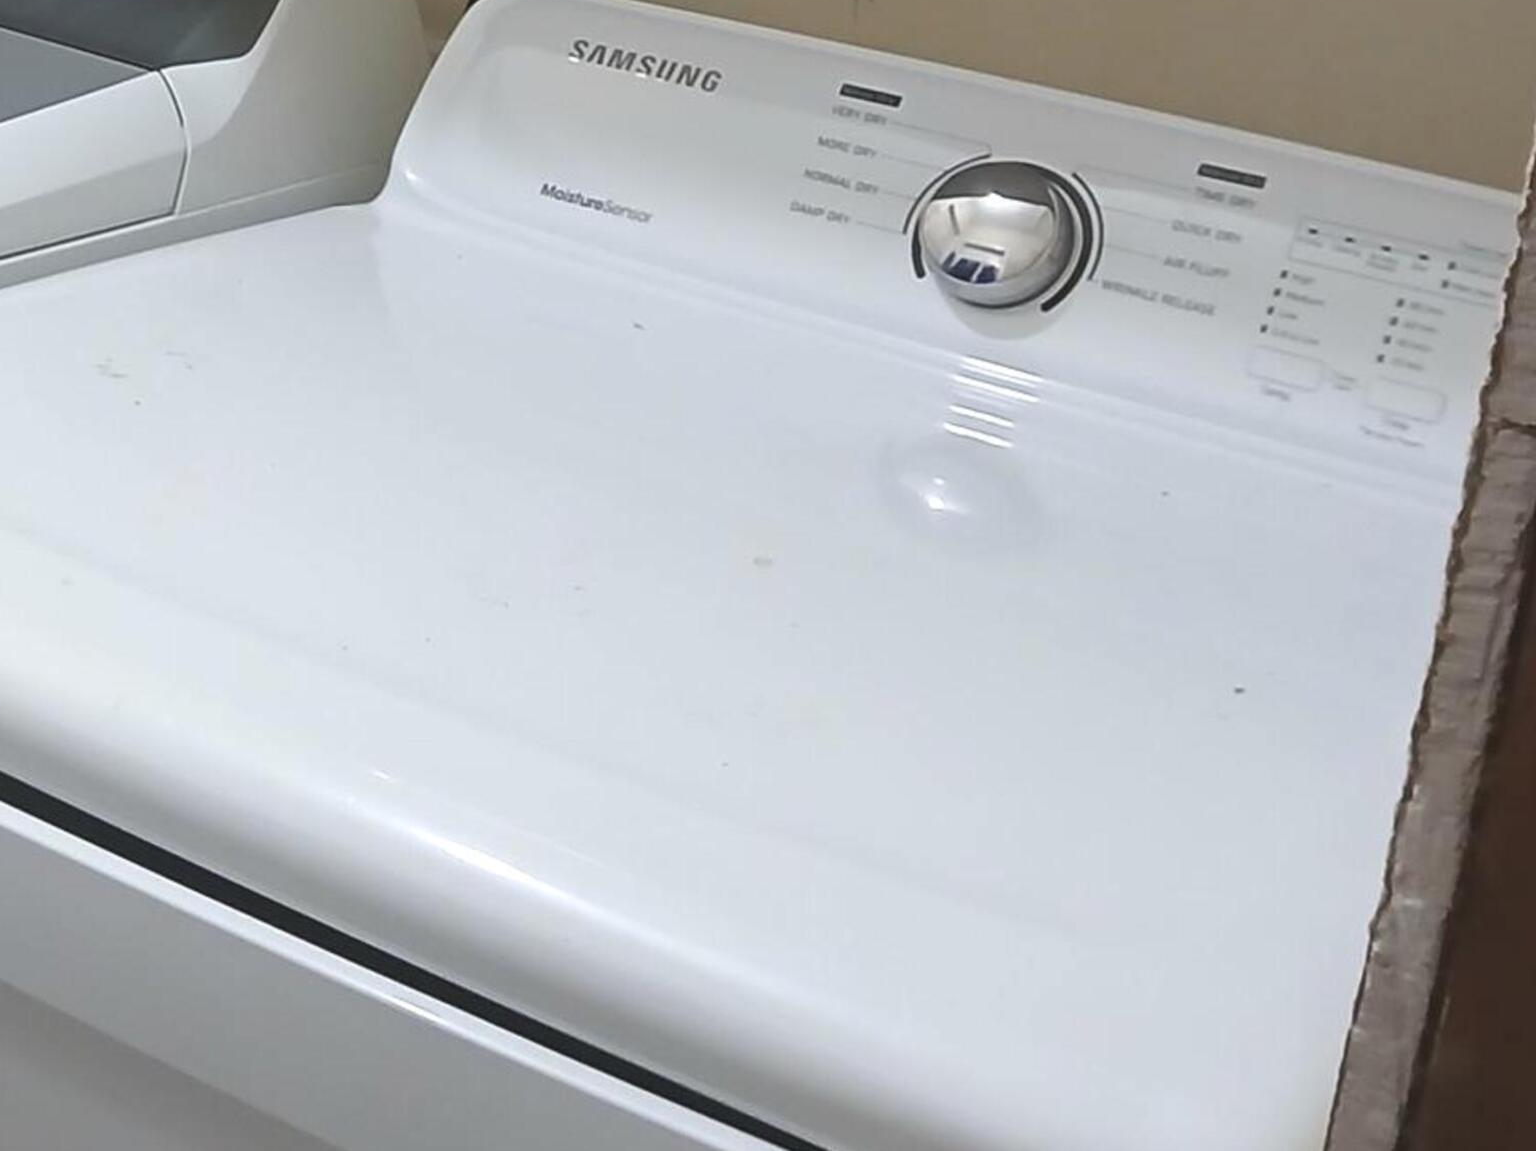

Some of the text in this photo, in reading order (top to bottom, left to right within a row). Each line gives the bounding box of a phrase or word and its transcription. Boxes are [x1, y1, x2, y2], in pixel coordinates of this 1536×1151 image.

[567, 38, 723, 94] SAMSUNG
[863, 111, 888, 126] DRY
[816, 135, 878, 159] MORE DRY
[803, 167, 880, 195] NORMAL DRY
[789, 200, 851, 225] DAMP DRY
[1161, 294, 1217, 316] RELEASE
